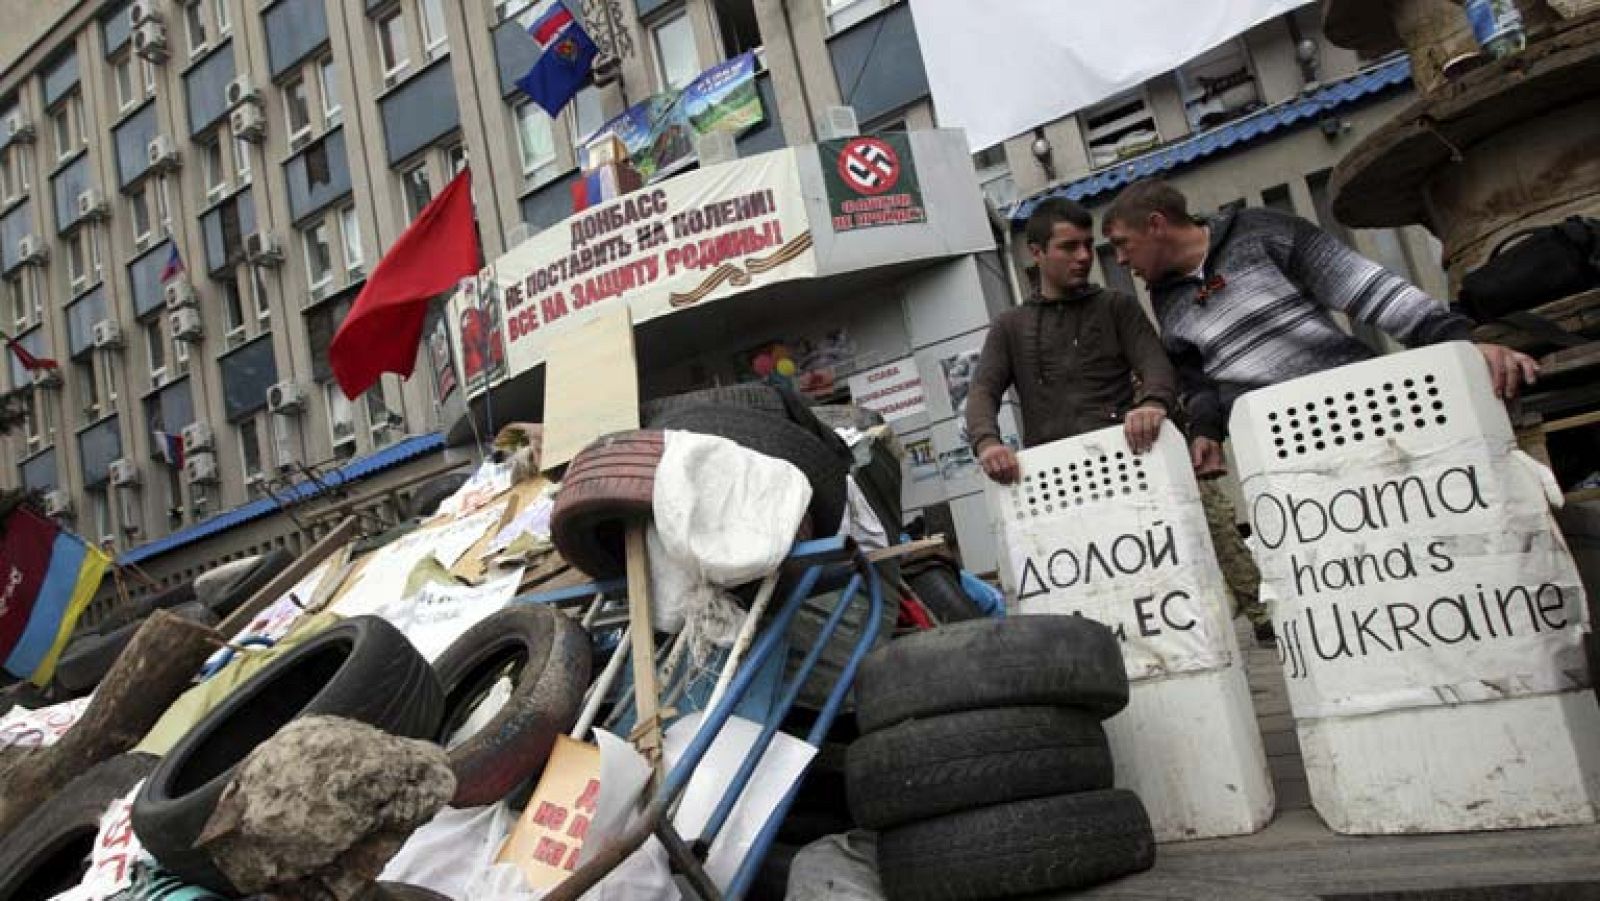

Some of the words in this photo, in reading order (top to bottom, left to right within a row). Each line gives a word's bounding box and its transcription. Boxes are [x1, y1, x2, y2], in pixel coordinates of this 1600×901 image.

[505, 281, 523, 310] НЕ
[526, 235, 631, 298] ПОСТАВИТЬ
[637, 221, 669, 250] НА
[671, 189, 775, 238] КОЛЕНИ!
[571, 189, 667, 250] ДОНБАСС
[508, 304, 540, 342] ВСЕ
[541, 292, 568, 323] НА
[571, 254, 659, 309] ЗАЩИТУ
[1254, 465, 1488, 549] Obama
[1018, 521, 1178, 600] ДОЛОЙ
[1291, 541, 1454, 596] hands
[1133, 590, 1196, 637] ЕС
